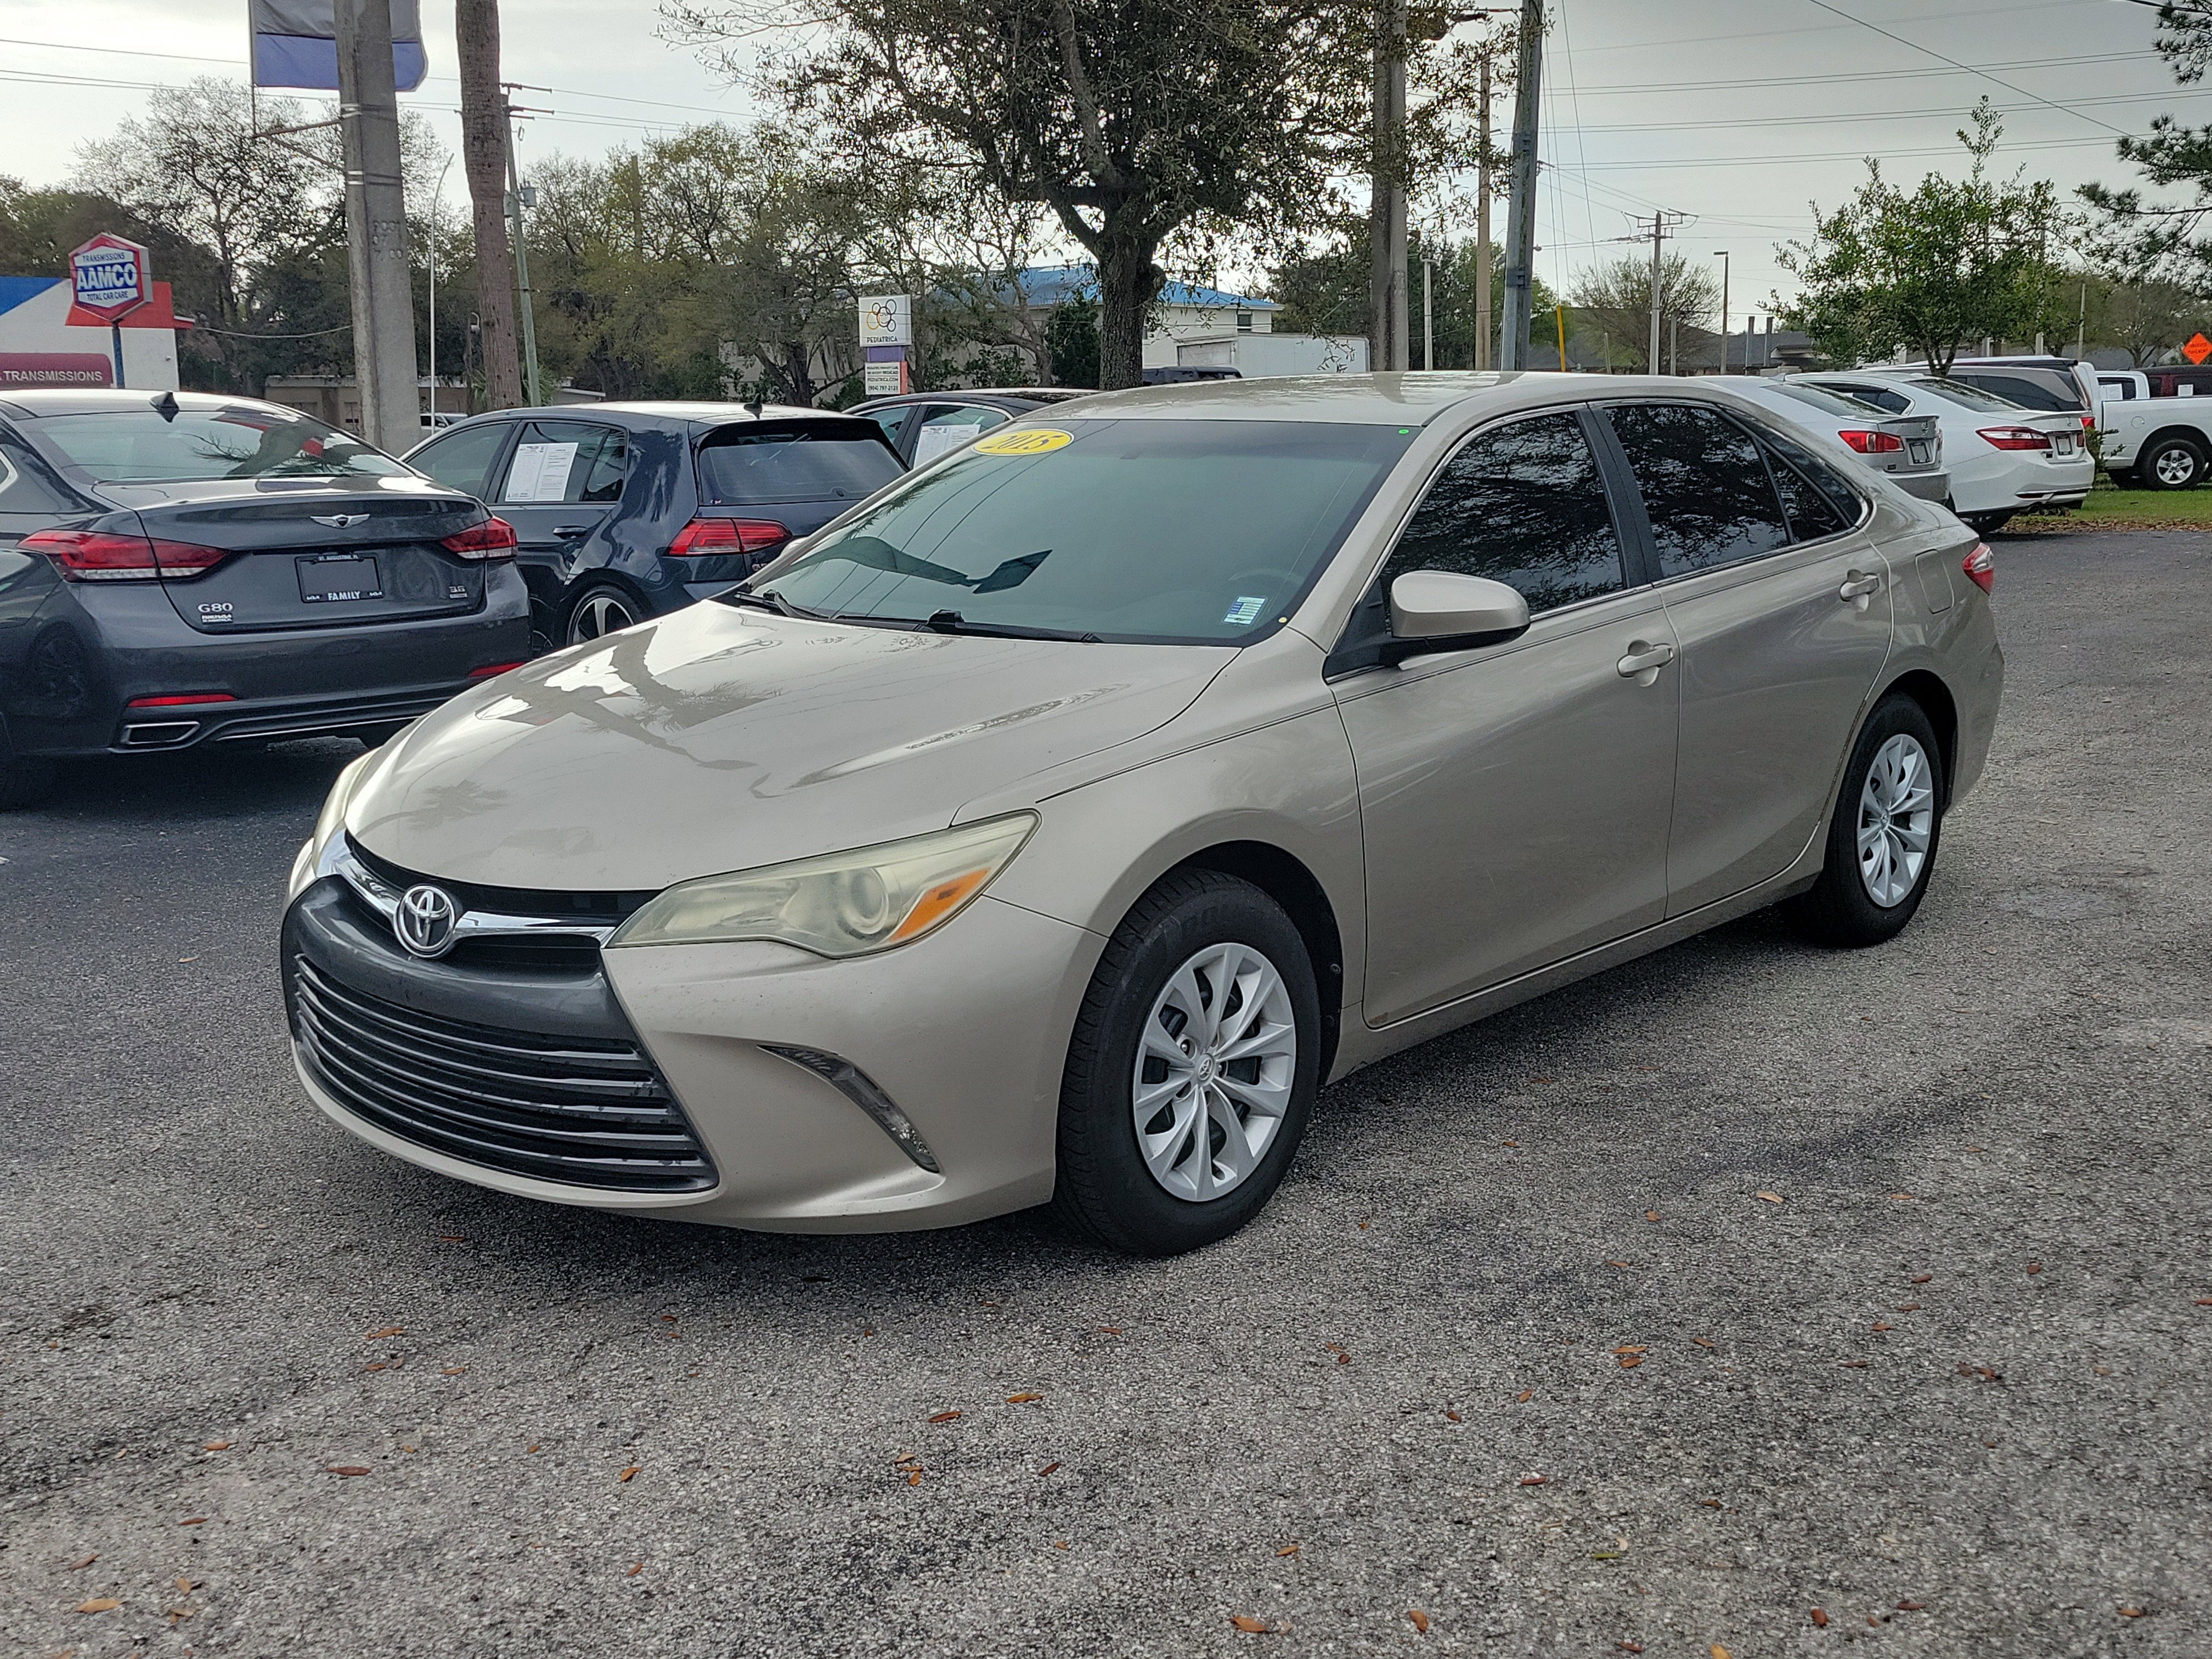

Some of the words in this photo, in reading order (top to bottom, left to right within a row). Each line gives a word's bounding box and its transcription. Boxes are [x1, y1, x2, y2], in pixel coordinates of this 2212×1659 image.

[83, 252, 125, 262] TRANSMISSIONS
[77, 263, 137, 290] AAMCO
[87, 293, 103, 301] TOTAL
[103, 292, 114, 300] CAR
[114, 290, 129, 299] CARE
[3, 370, 103, 381] TRANSMISSIONS
[980, 434, 1065, 450] 2015
[328, 591, 361, 601] FAMILY
[198, 602, 233, 613] G80
